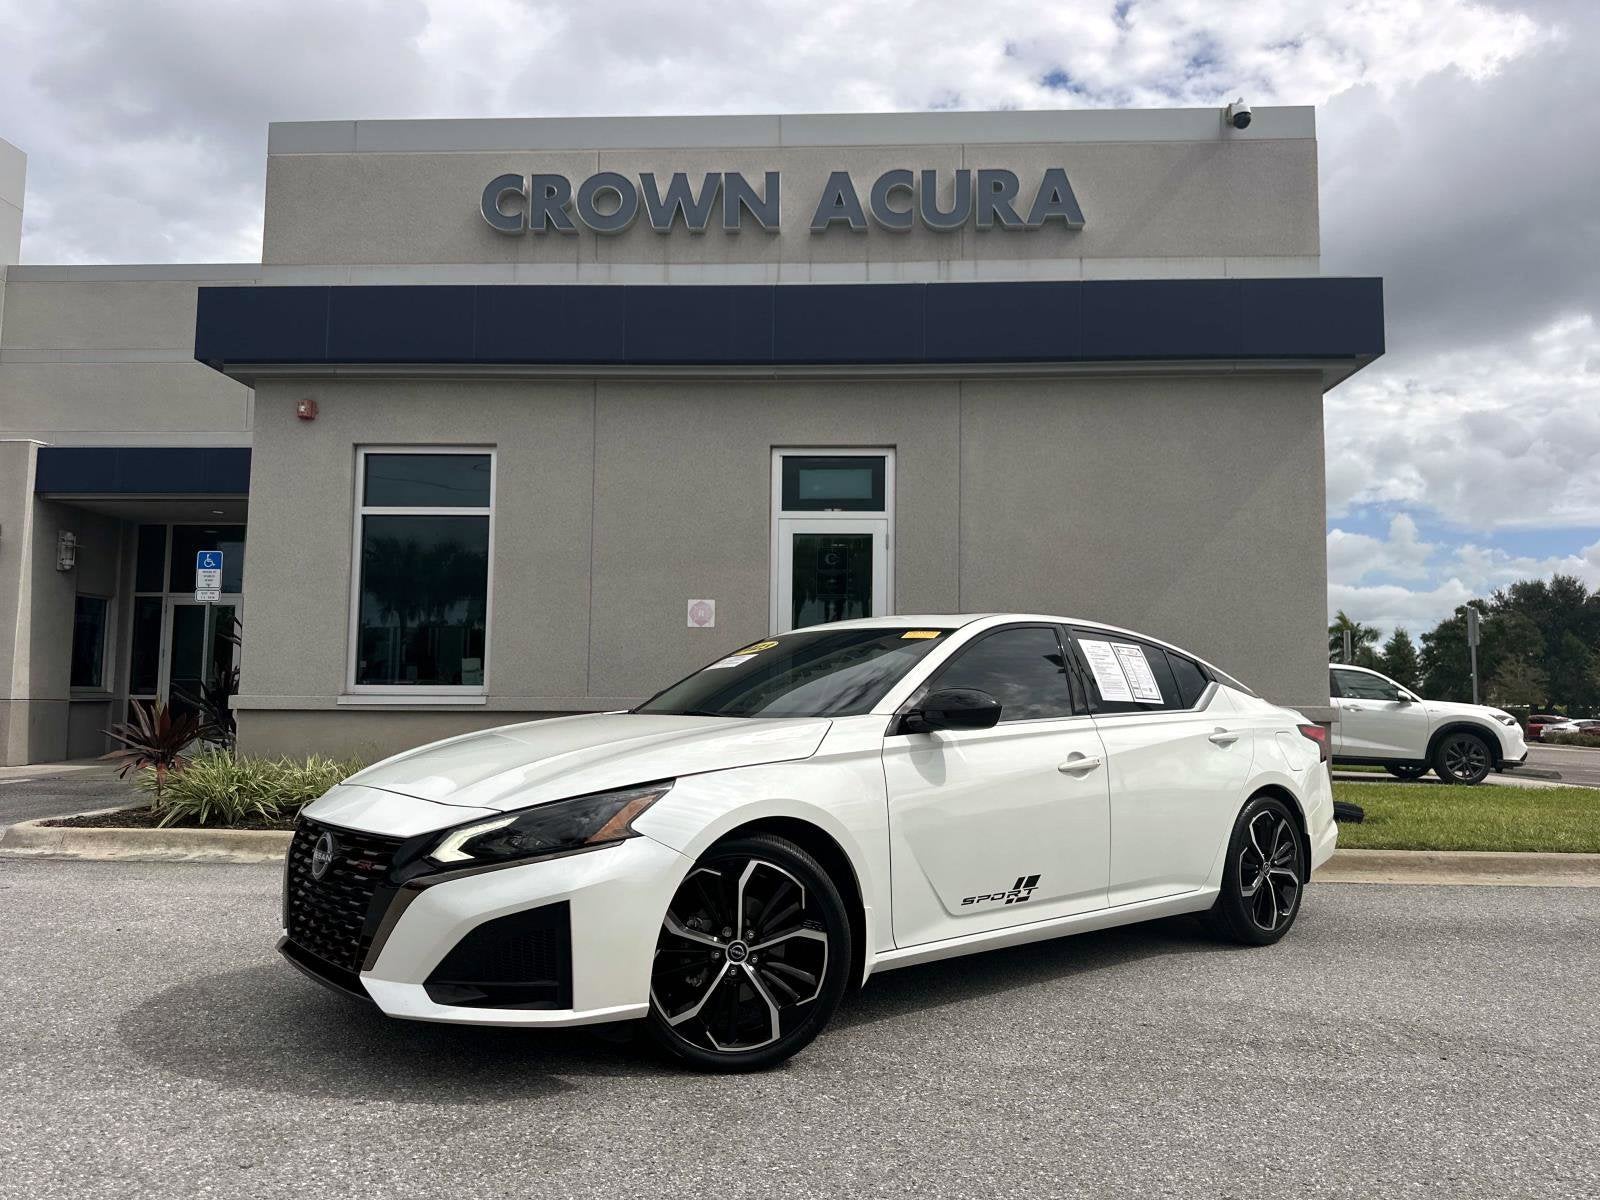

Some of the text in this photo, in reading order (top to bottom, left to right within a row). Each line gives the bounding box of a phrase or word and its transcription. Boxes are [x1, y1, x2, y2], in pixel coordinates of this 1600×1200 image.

[480, 168, 1086, 234] CROWN ACURA
[961, 886, 1039, 906] SPORT
